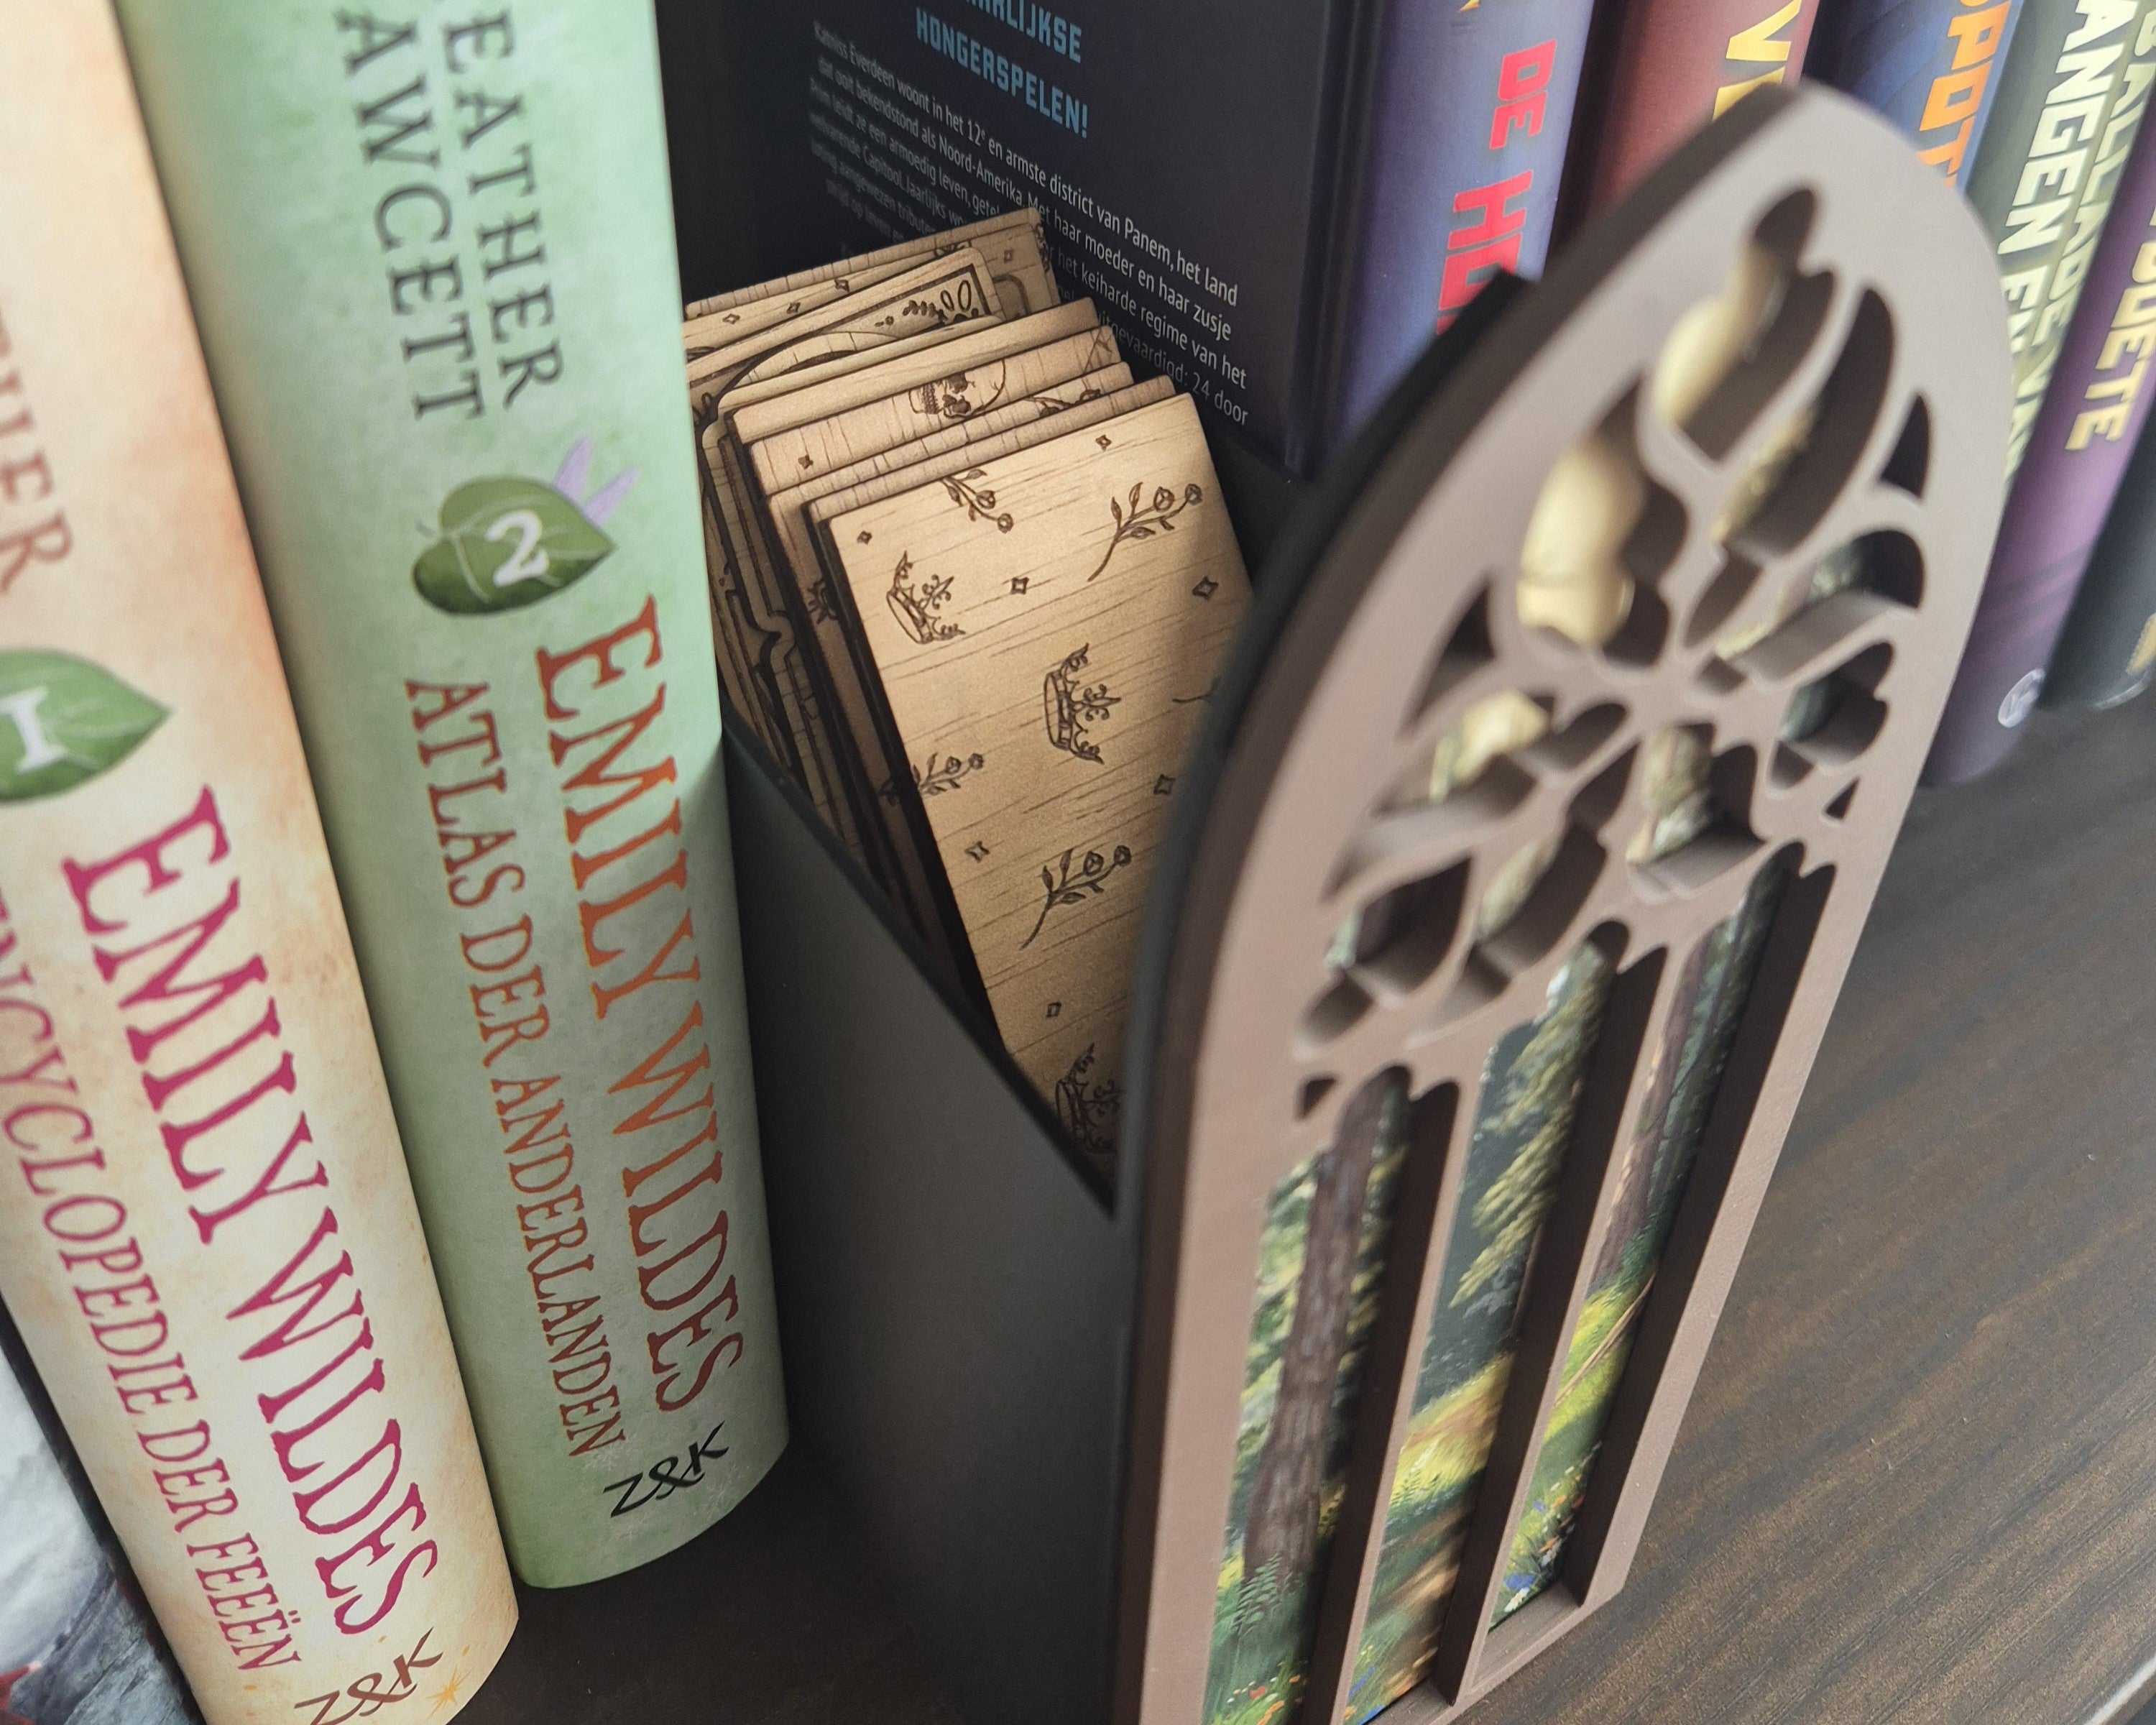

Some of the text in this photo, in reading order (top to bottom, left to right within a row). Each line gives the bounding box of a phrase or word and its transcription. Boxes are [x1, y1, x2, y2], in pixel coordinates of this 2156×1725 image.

[916, 6, 1088, 139] HONGERSPELEN!
[967, 0, 1082, 63] RLIJKSE
[1917, 0, 2011, 188] POT
[1997, 0, 2138, 254] ANGEN
[332, 6, 487, 423] AWCETT
[441, 6, 564, 413] EATHER
[849, 41, 895, 90] Everdeen
[897, 78, 929, 113] woont
[933, 97, 943, 121] in
[946, 105, 964, 135] het
[988, 138, 1003, 160] en
[1006, 149, 1046, 188] armste
[1050, 173, 1094, 218] district
[1097, 205, 1120, 234] van
[1125, 217, 1174, 272] Panem,
[1176, 250, 1200, 285] het
[1204, 267, 1238, 307] land
[855, 77, 919, 137] bekendstond
[921, 125, 936, 150] als
[939, 133, 1026, 208] Noord-Amerika.
[1028, 191, 1051, 225] Met
[1054, 209, 1082, 244] haar
[1085, 234, 1134, 278] moeder
[1138, 268, 1155, 293] en
[1158, 275, 1190, 315] haar
[1193, 304, 1231, 341] zusje
[869, 124, 886, 145] een
[888, 137, 936, 185] armoedig
[939, 166, 972, 208] leven,
[1058, 252, 1078, 278] het
[1082, 262, 1137, 317] keiharde
[1141, 305, 1187, 351] regime
[1192, 340, 1217, 370] van
[1222, 354, 1246, 390] het
[1437, 39, 1557, 336] DE HO
[1193, 371, 1210, 400] 24
[1214, 390, 1248, 425] door
[487, 510, 549, 586] 2
[2, 687, 66, 773] 1
[405, 679, 627, 1457] ATLAS DER ANDERLANDEN
[535, 594, 745, 1412] EMILY WILDES
[0, 888, 302, 1671] CYCLOPEDIE DER FEEËN
[62, 785, 438, 1635] EMILY WILDES
